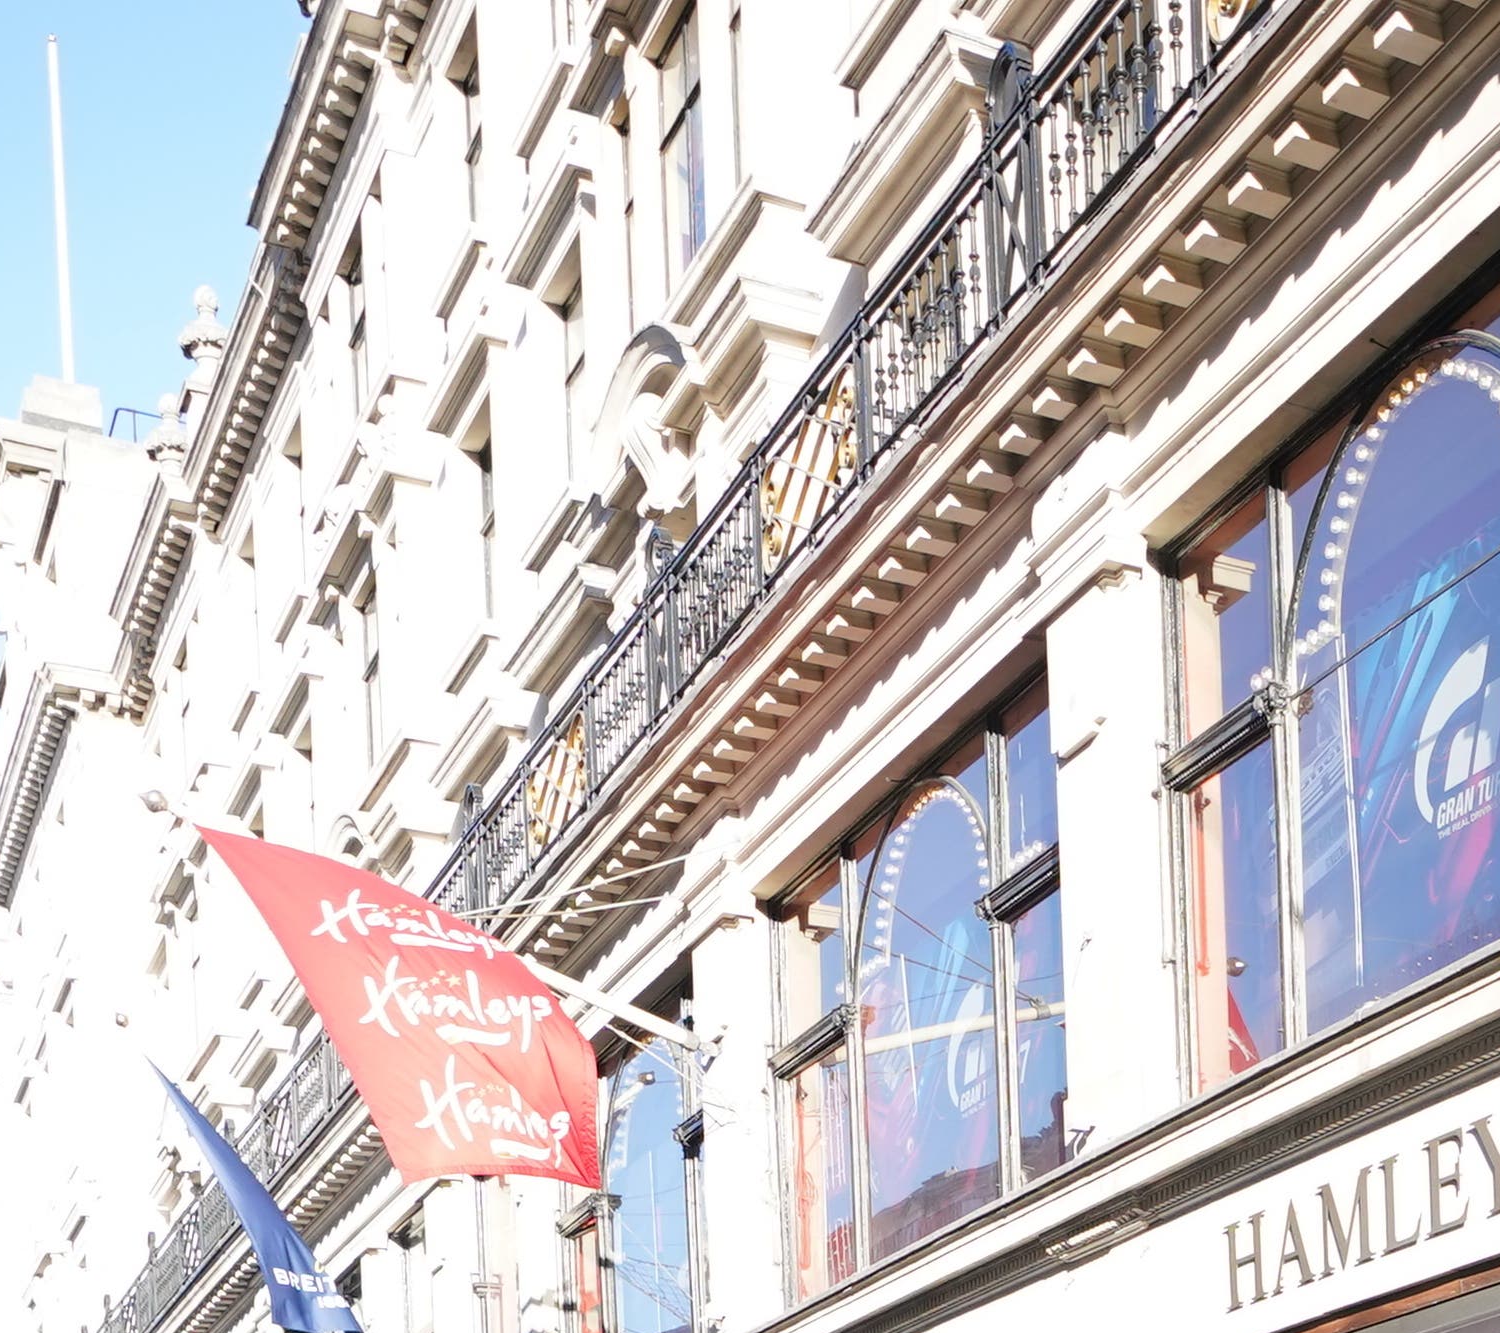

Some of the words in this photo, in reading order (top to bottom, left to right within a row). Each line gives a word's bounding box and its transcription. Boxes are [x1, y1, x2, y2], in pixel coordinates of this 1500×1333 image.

[1436, 785, 1475, 830] GRAN
[310, 888, 510, 959] Hamleys
[359, 955, 552, 1053] Hamleys
[273, 1267, 337, 1293] BREIT
